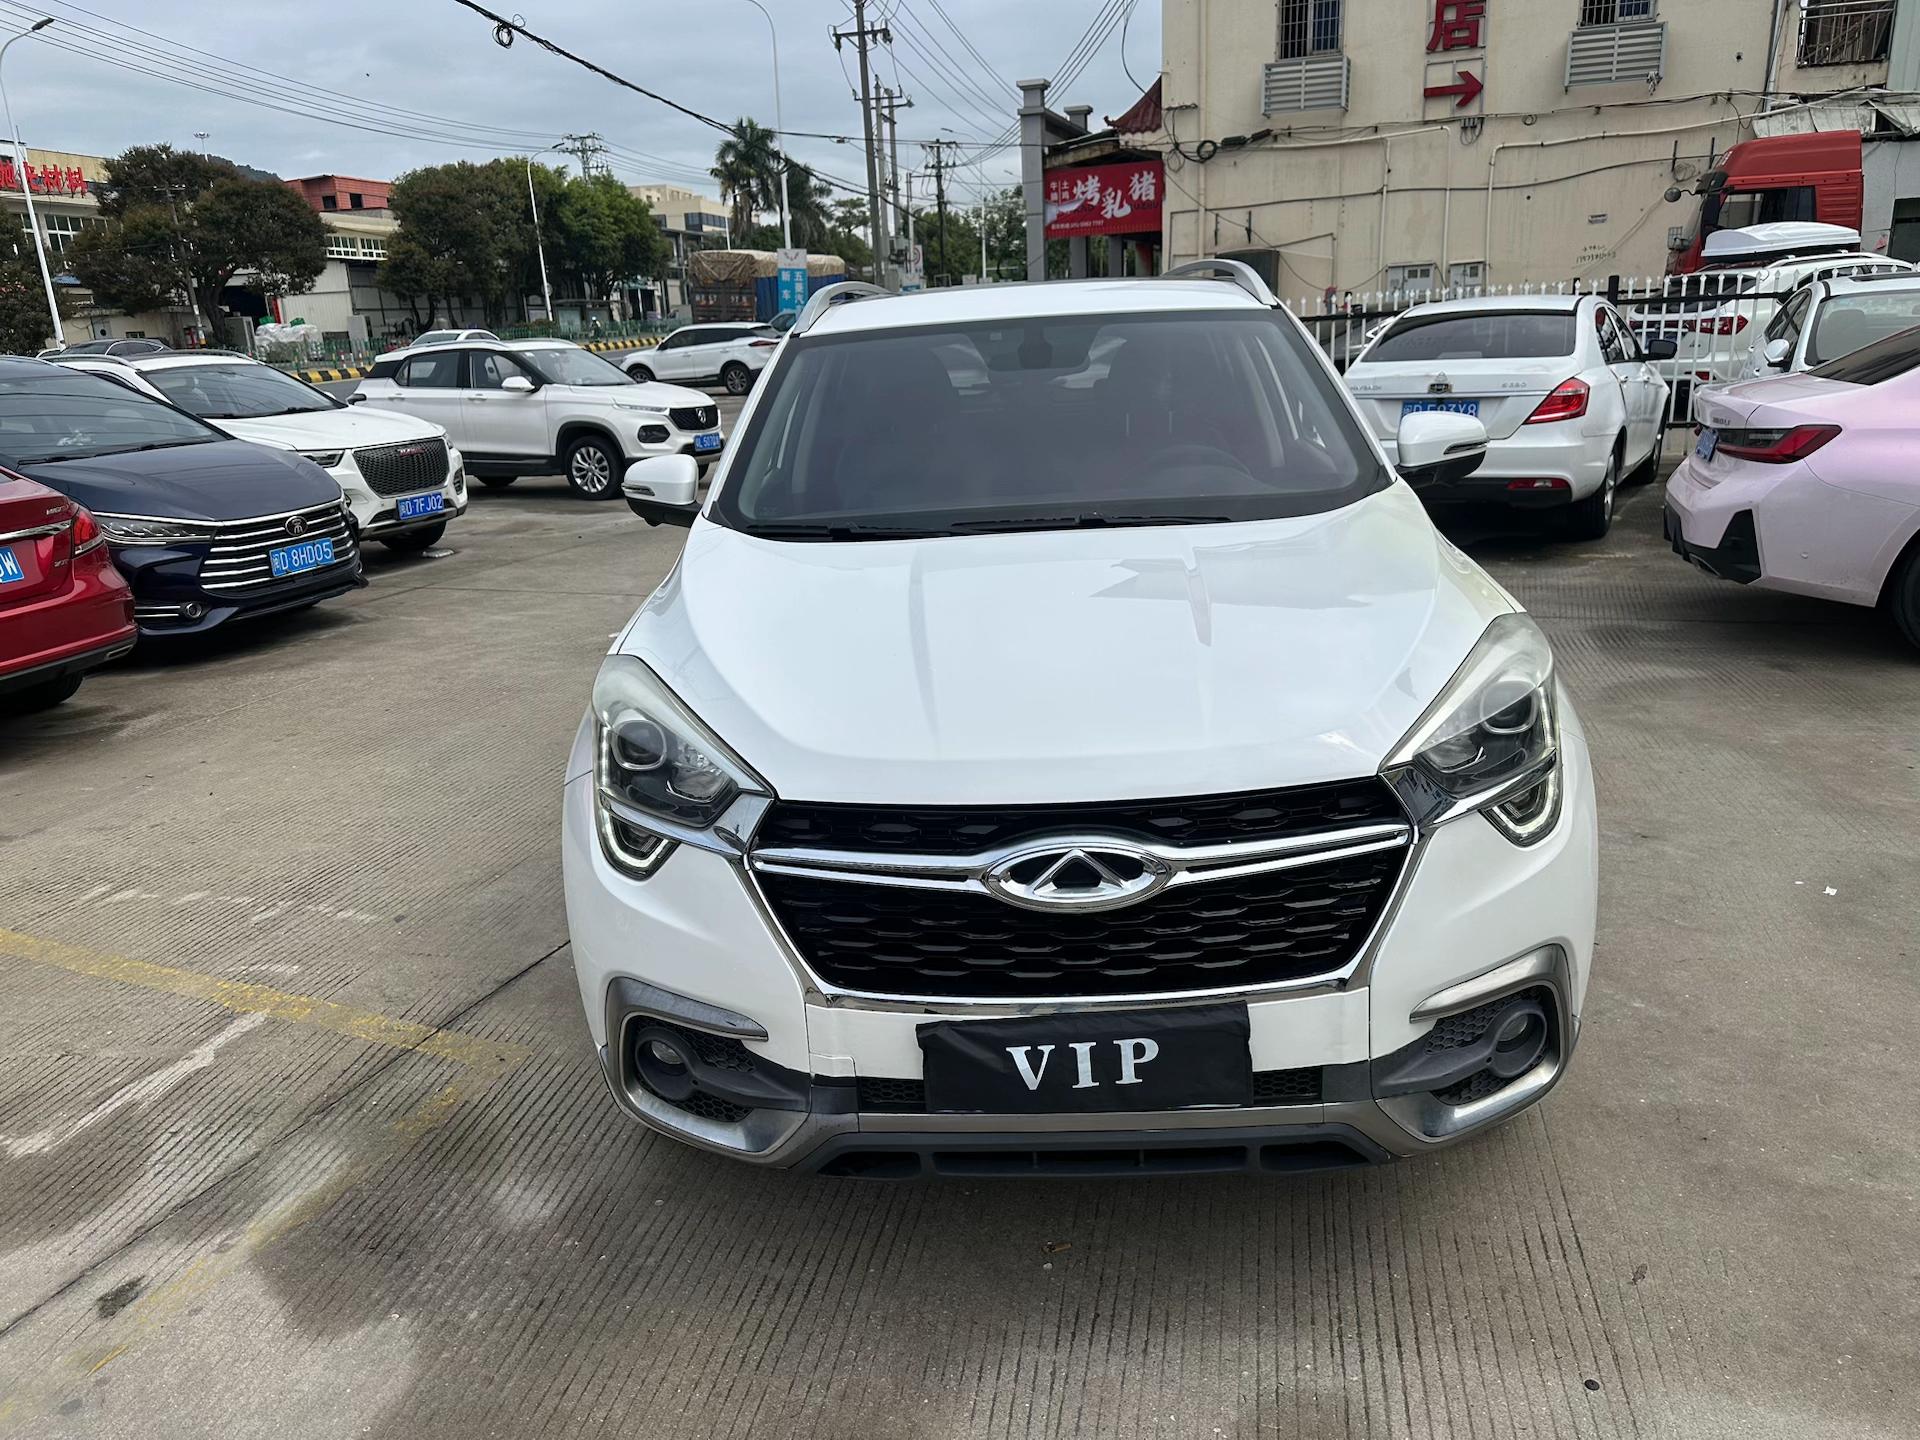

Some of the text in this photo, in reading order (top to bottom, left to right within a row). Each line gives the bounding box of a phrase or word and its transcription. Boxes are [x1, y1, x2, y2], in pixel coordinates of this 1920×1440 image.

[1426, 0, 1486, 52] 店
[1073, 171, 1156, 219] 烤乳猪
[1006, 1037, 1159, 1090] VIP
